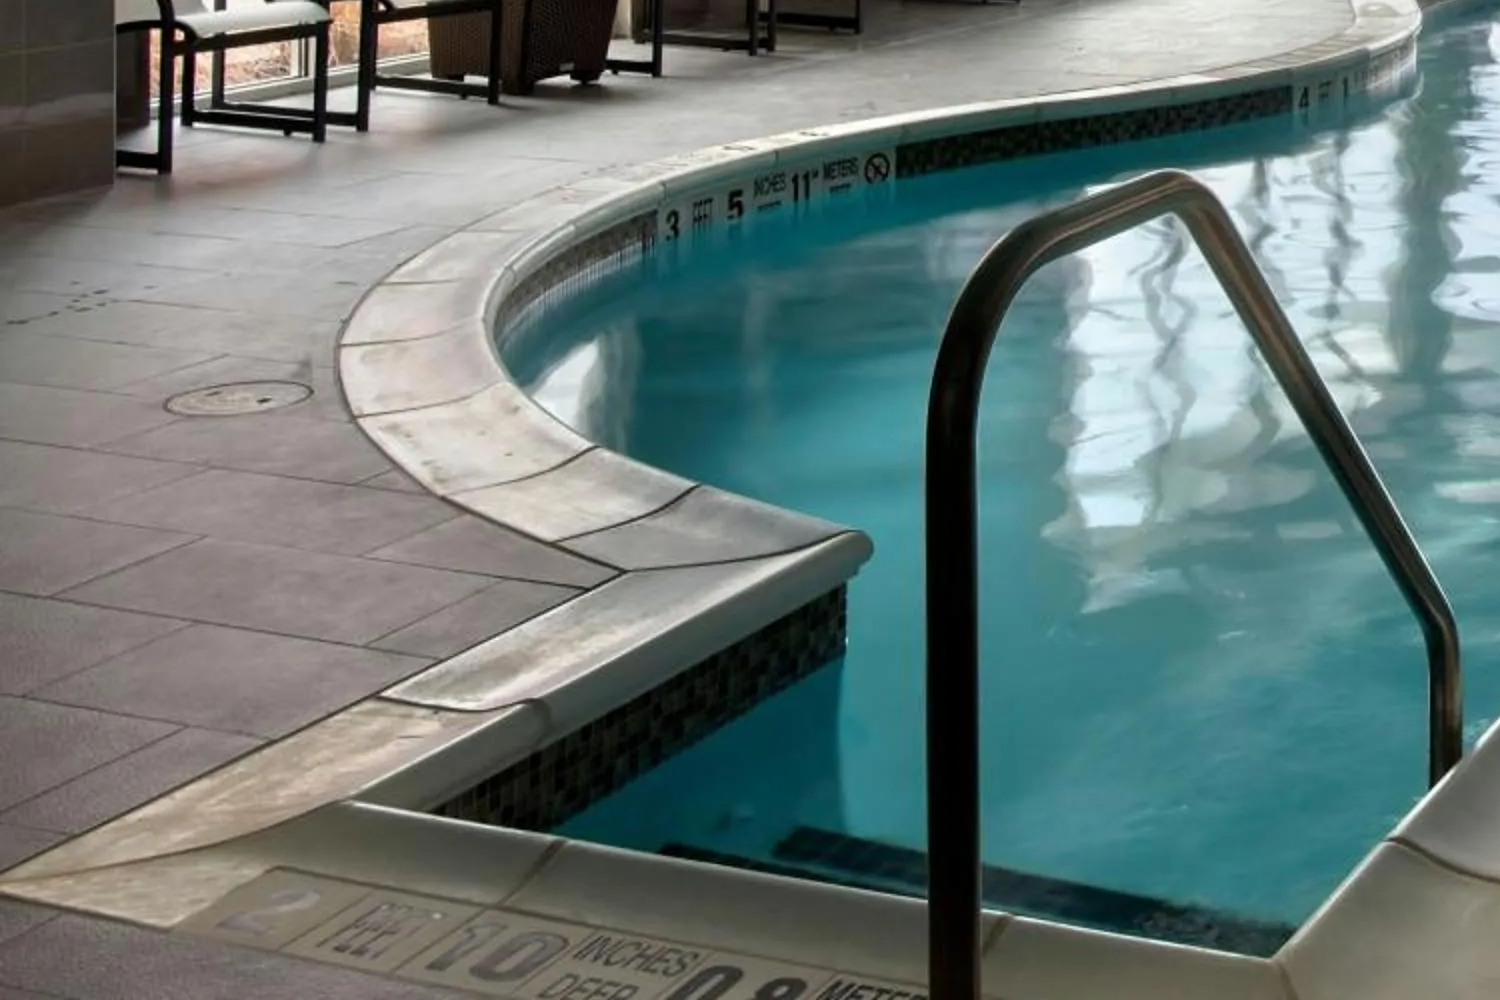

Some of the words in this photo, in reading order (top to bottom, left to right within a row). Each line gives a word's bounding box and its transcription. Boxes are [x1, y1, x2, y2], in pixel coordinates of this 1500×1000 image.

[665, 210, 679, 241] 3
[727, 189, 744, 220] 5
[823, 156, 859, 181] METERS
[425, 922, 571, 982] 10
[572, 934, 700, 977] INCHES
